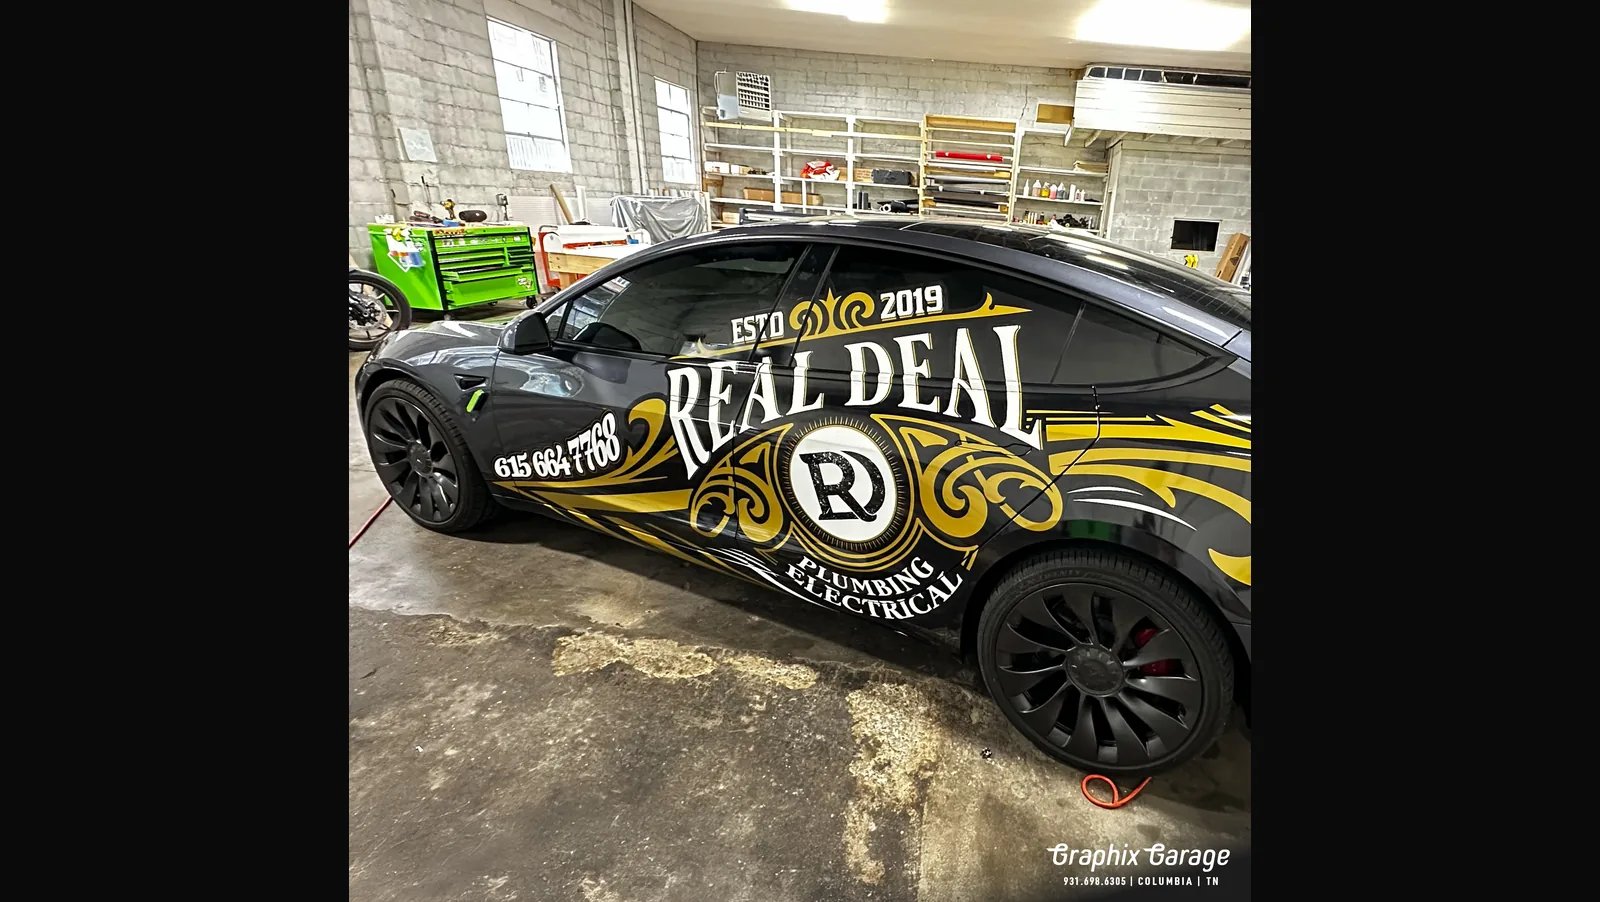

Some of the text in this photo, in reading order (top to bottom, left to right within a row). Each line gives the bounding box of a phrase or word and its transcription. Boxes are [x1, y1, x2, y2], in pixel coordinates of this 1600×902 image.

[880, 285, 943, 321] 2019
[667, 325, 1044, 480] REAL DEAL
[494, 412, 620, 477] 615 664 7768
[785, 571, 963, 620] ELECTRICAL
[797, 556, 934, 597] PLUMBING
